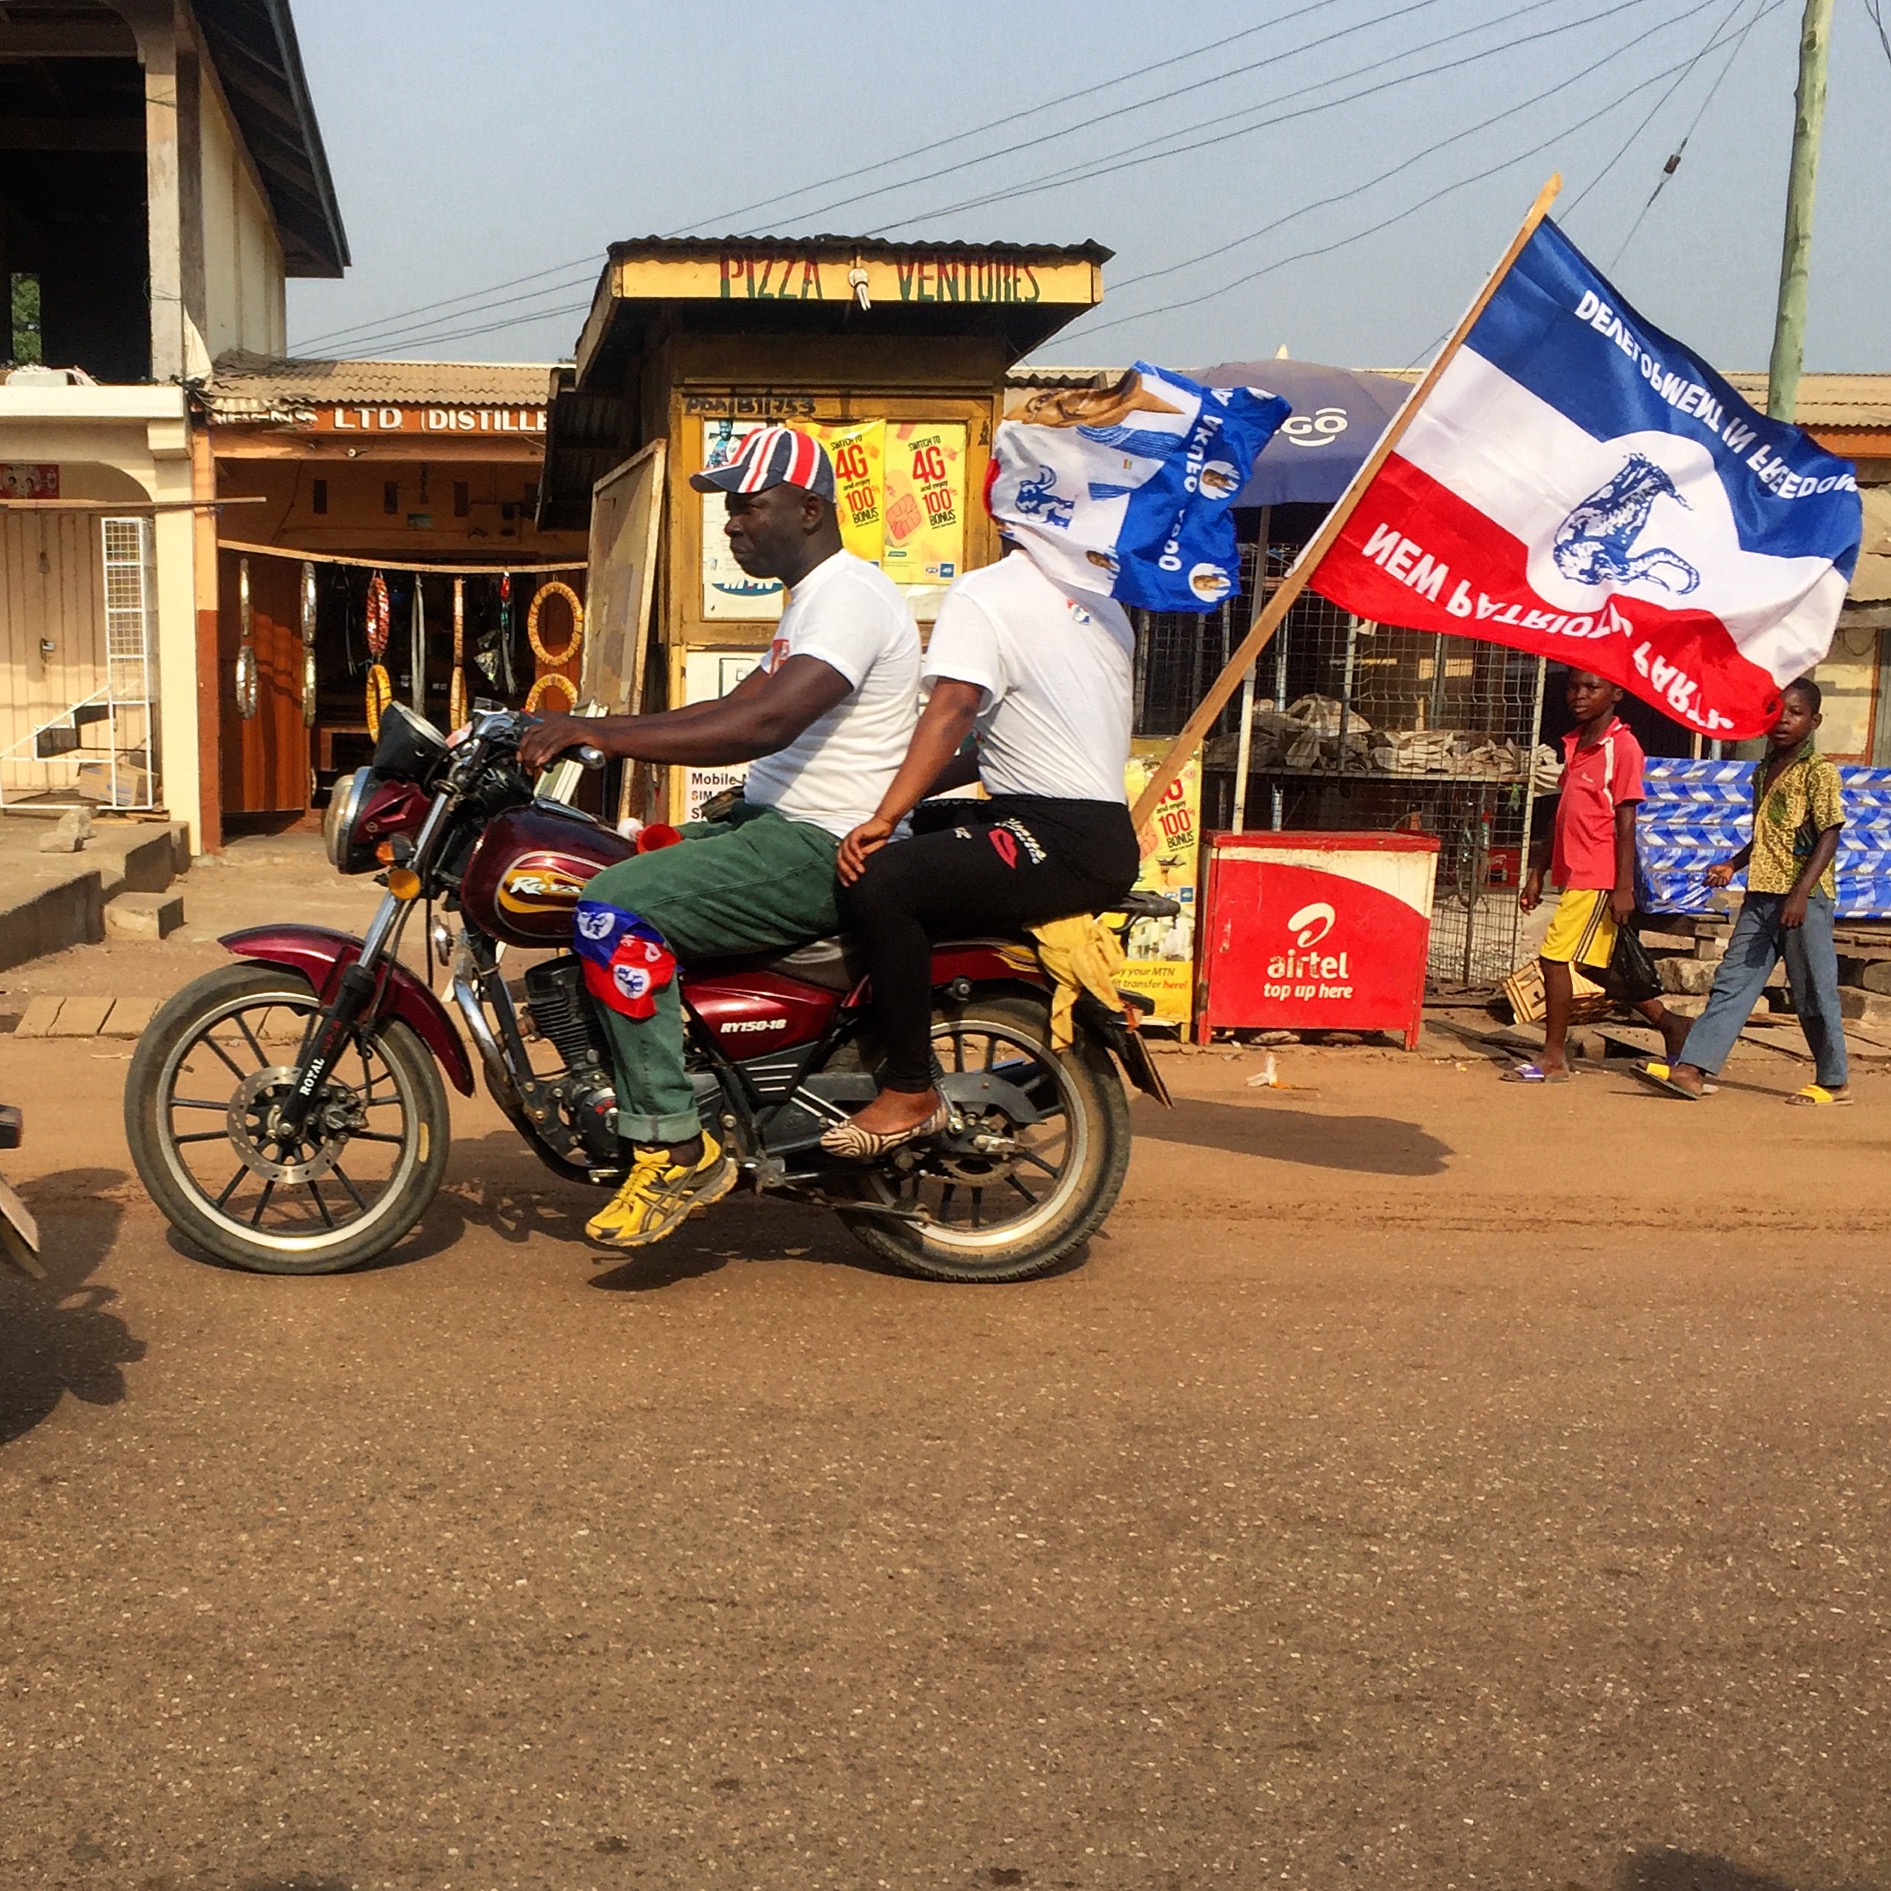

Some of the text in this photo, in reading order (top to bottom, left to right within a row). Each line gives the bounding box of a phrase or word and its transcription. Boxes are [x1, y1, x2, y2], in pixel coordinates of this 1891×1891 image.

[720, 253, 824, 300] PIZZA
[835, 444, 869, 482] 4G
[912, 446, 946, 484] 4G
[852, 506, 879, 524] BONUS
[929, 509, 956, 527] BONUS
[691, 772, 737, 785] Mobile
[1167, 830, 1195, 849] BONUS
[1128, 968, 1151, 977] your
[1151, 967, 1176, 976] MTN
[1267, 948, 1349, 979] airtel
[1123, 979, 1162, 989] transfer
[1263, 982, 1353, 1002] top up here
[299, 1058, 326, 1096] ROYAL
